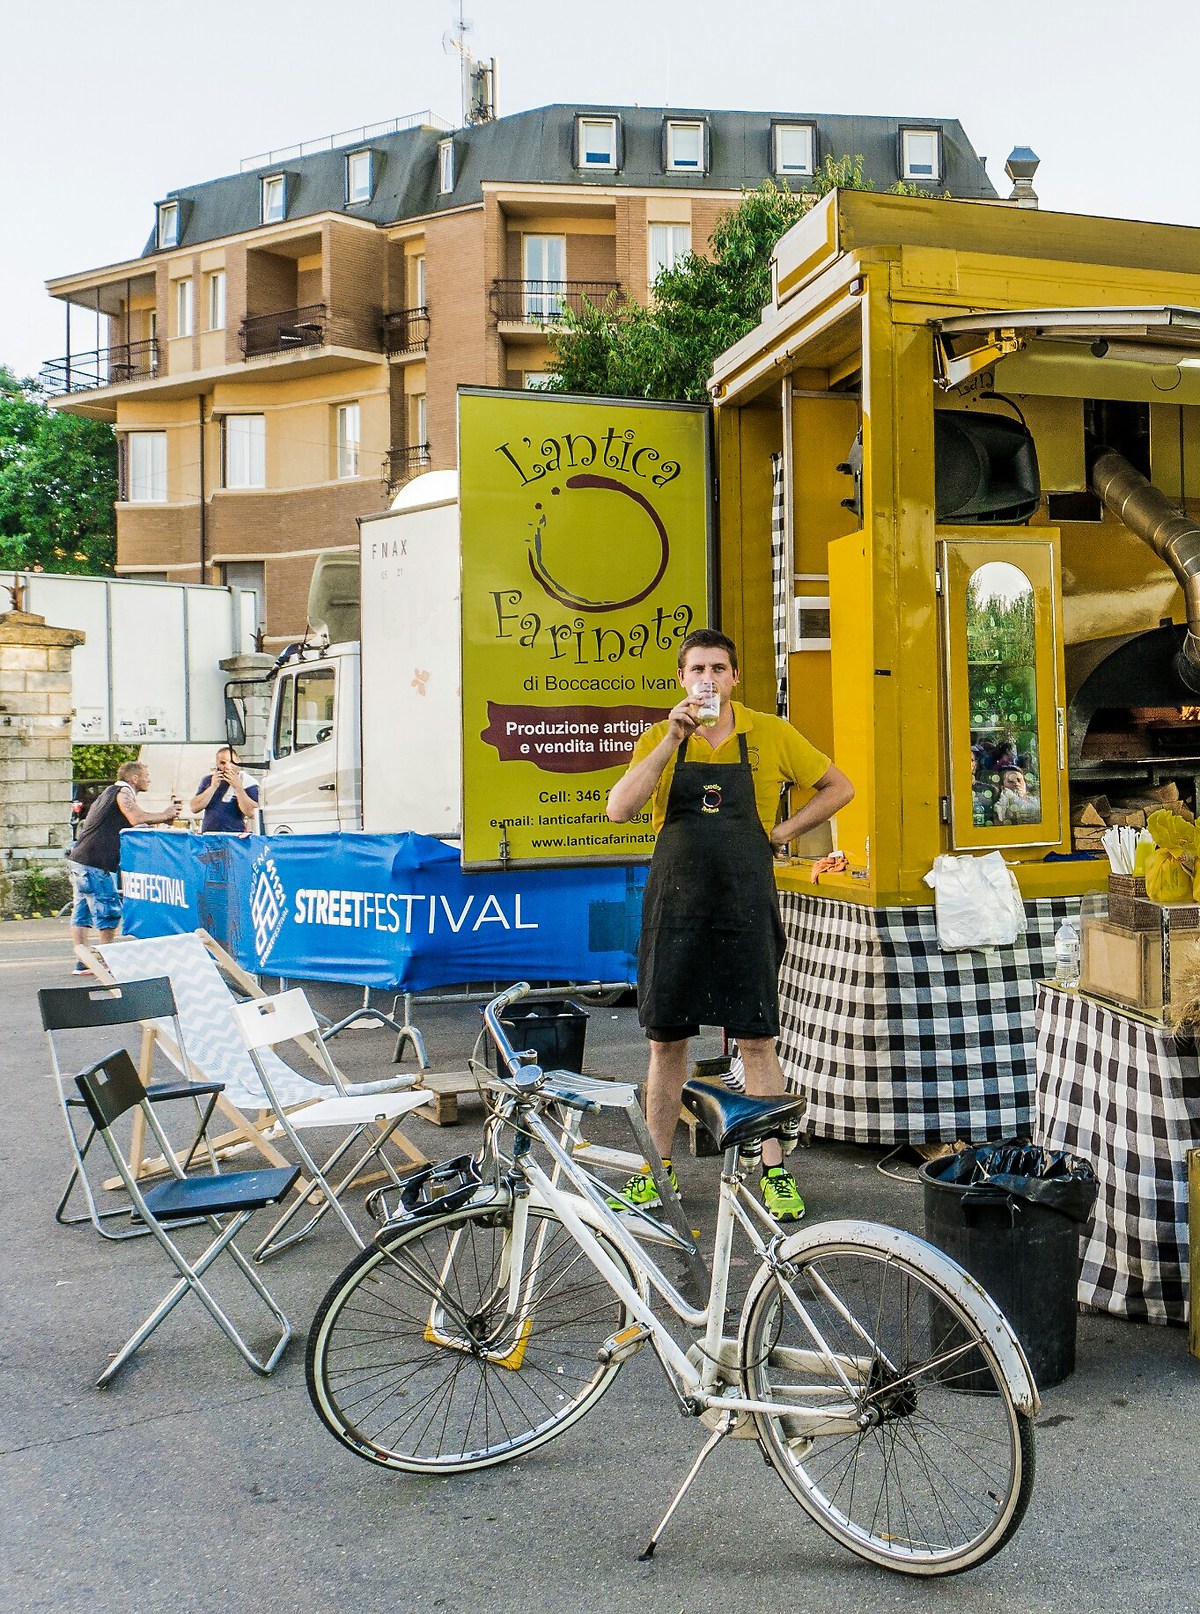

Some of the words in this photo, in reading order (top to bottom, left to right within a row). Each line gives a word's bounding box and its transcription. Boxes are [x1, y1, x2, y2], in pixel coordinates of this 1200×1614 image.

[495, 428, 681, 488] L'antica
[489, 589, 693, 664] Farinata
[523, 675, 538, 690] di
[545, 675, 635, 690] Boccaccio
[642, 674, 677, 690] Ivan
[506, 721, 599, 735] Produzione
[604, 719, 652, 736] artigia
[520, 742, 530, 753] e
[534, 739, 594, 753] vendita
[539, 790, 571, 803] Cell:
[576, 789, 601, 802] 346
[490, 815, 534, 828] e-mail:
[531, 833, 656, 848] www.lanticafarinata
[294, 888, 539, 934] STREETFESTIVAL
